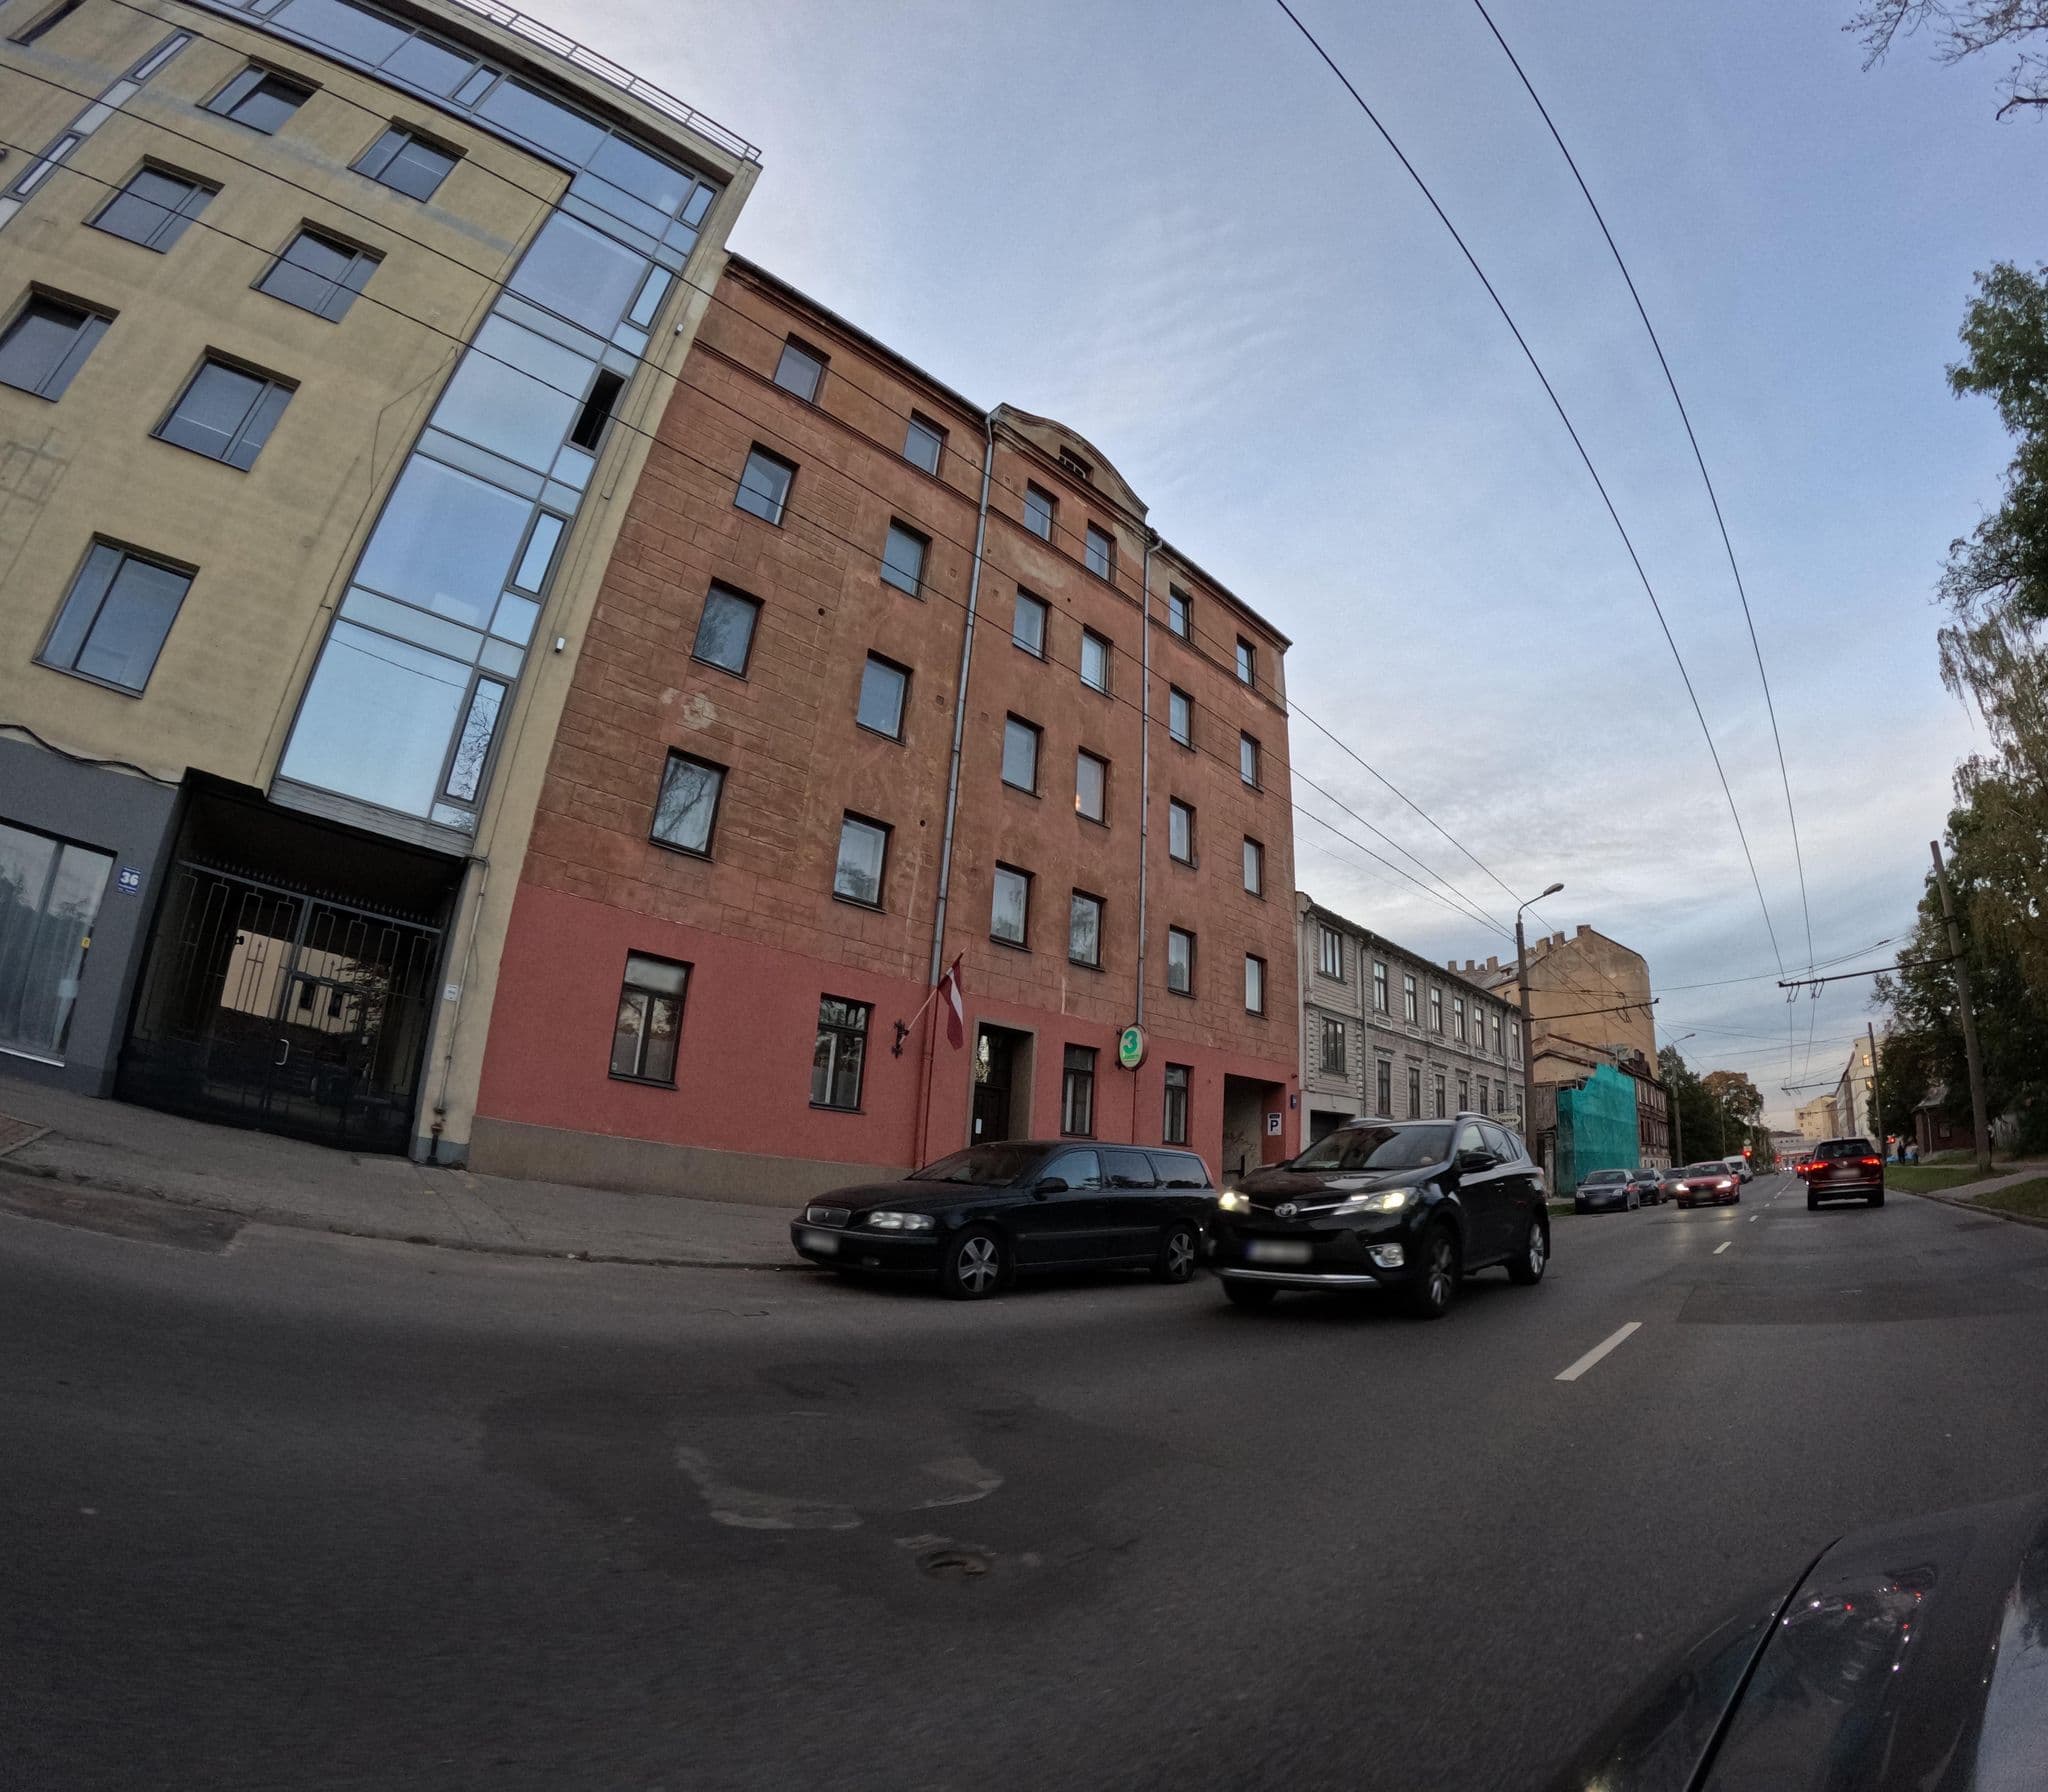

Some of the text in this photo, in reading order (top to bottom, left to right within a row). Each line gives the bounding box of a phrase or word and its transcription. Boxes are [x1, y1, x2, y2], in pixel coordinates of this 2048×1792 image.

[120, 871, 139, 886] 36
[1123, 1030, 1137, 1054] 3
[1270, 1119, 1279, 1132] P
